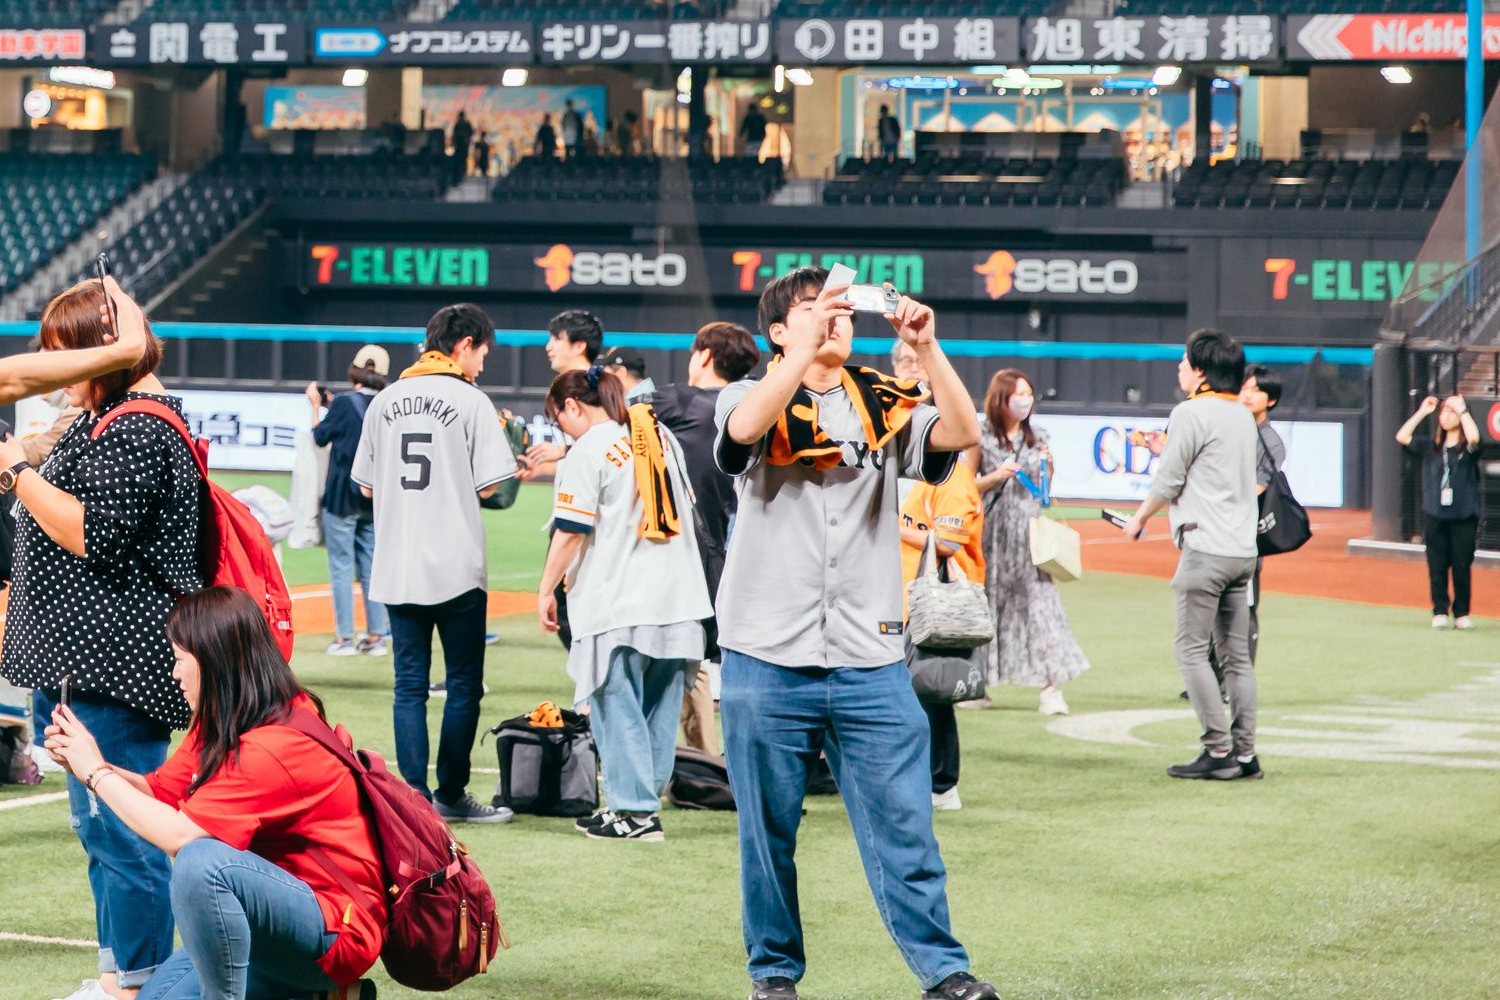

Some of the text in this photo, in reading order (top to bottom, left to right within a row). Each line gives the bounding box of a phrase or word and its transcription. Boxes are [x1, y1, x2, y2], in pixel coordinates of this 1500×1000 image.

[148, 21, 289, 64] 関電工
[388, 29, 531, 55] ナフコシステム
[542, 22, 770, 61] キリン一番搾り
[844, 16, 997, 62] 田中組
[1031, 14, 1274, 63] 旭東清掃
[382, 396, 459, 428] KADOWAKI
[400, 433, 433, 491] 5
